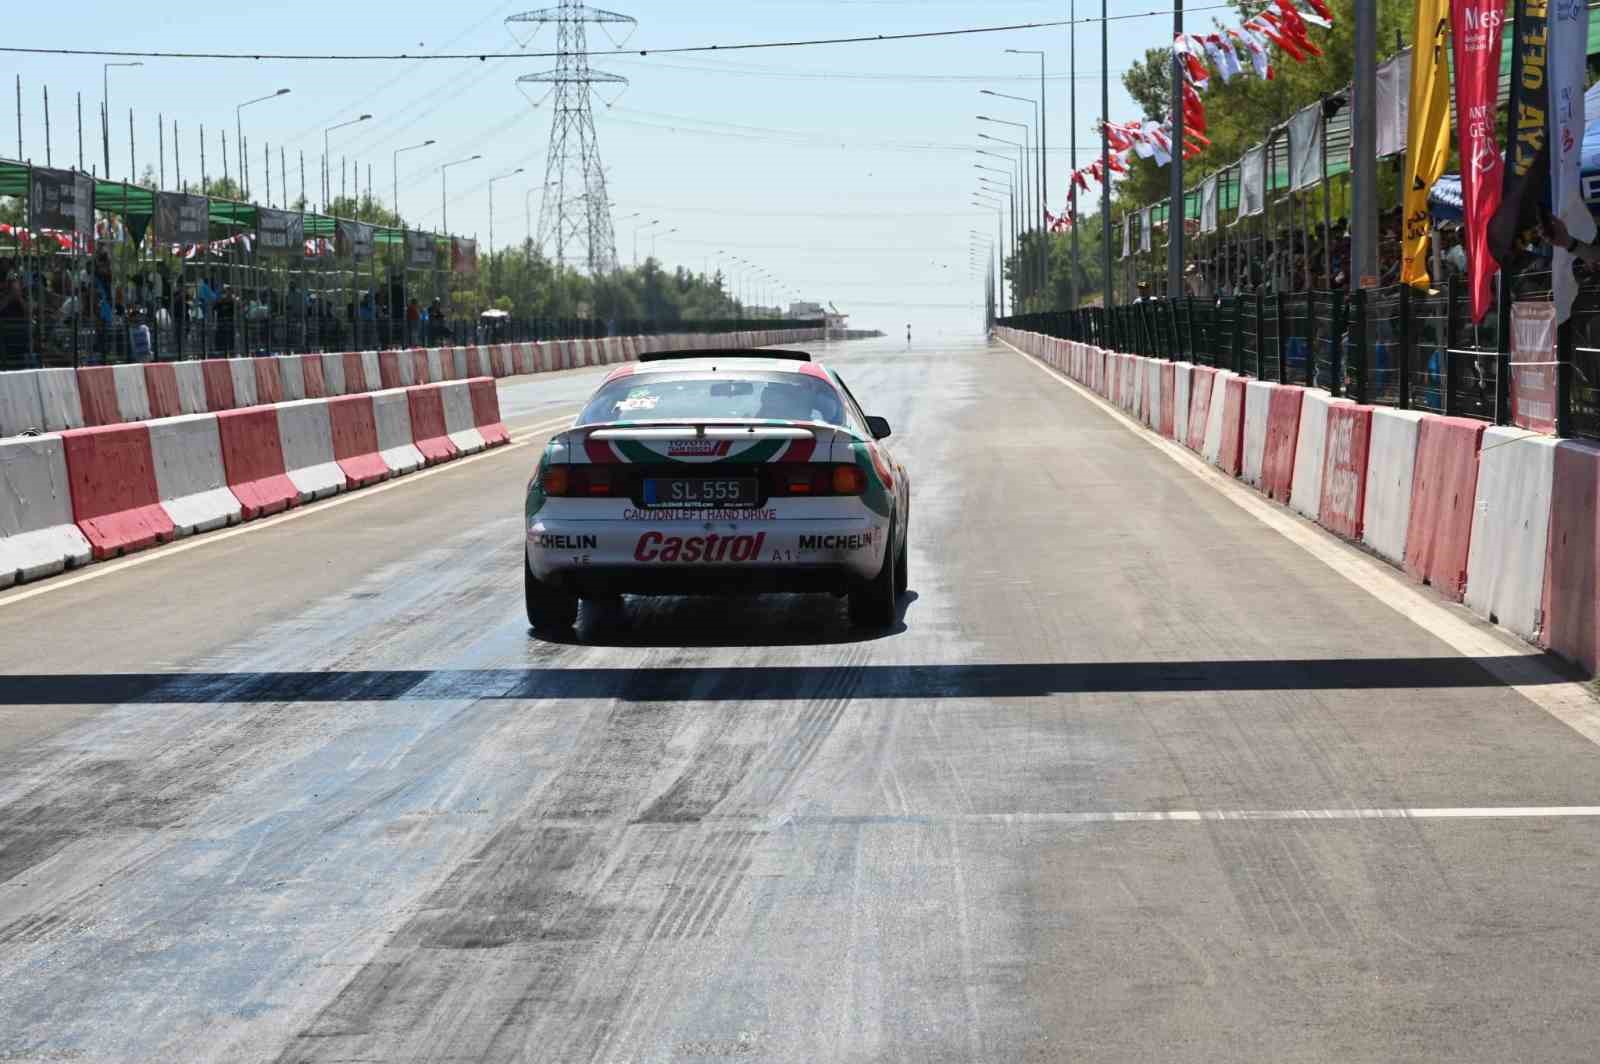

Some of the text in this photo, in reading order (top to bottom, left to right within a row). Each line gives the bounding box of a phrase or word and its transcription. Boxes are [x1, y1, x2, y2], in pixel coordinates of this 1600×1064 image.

[671, 481, 740, 500] SL 555
[623, 508, 777, 521] CAUTION LEFT HAND DRIVE
[633, 530, 768, 562] Castrol
[799, 531, 873, 551] MICHELIN
